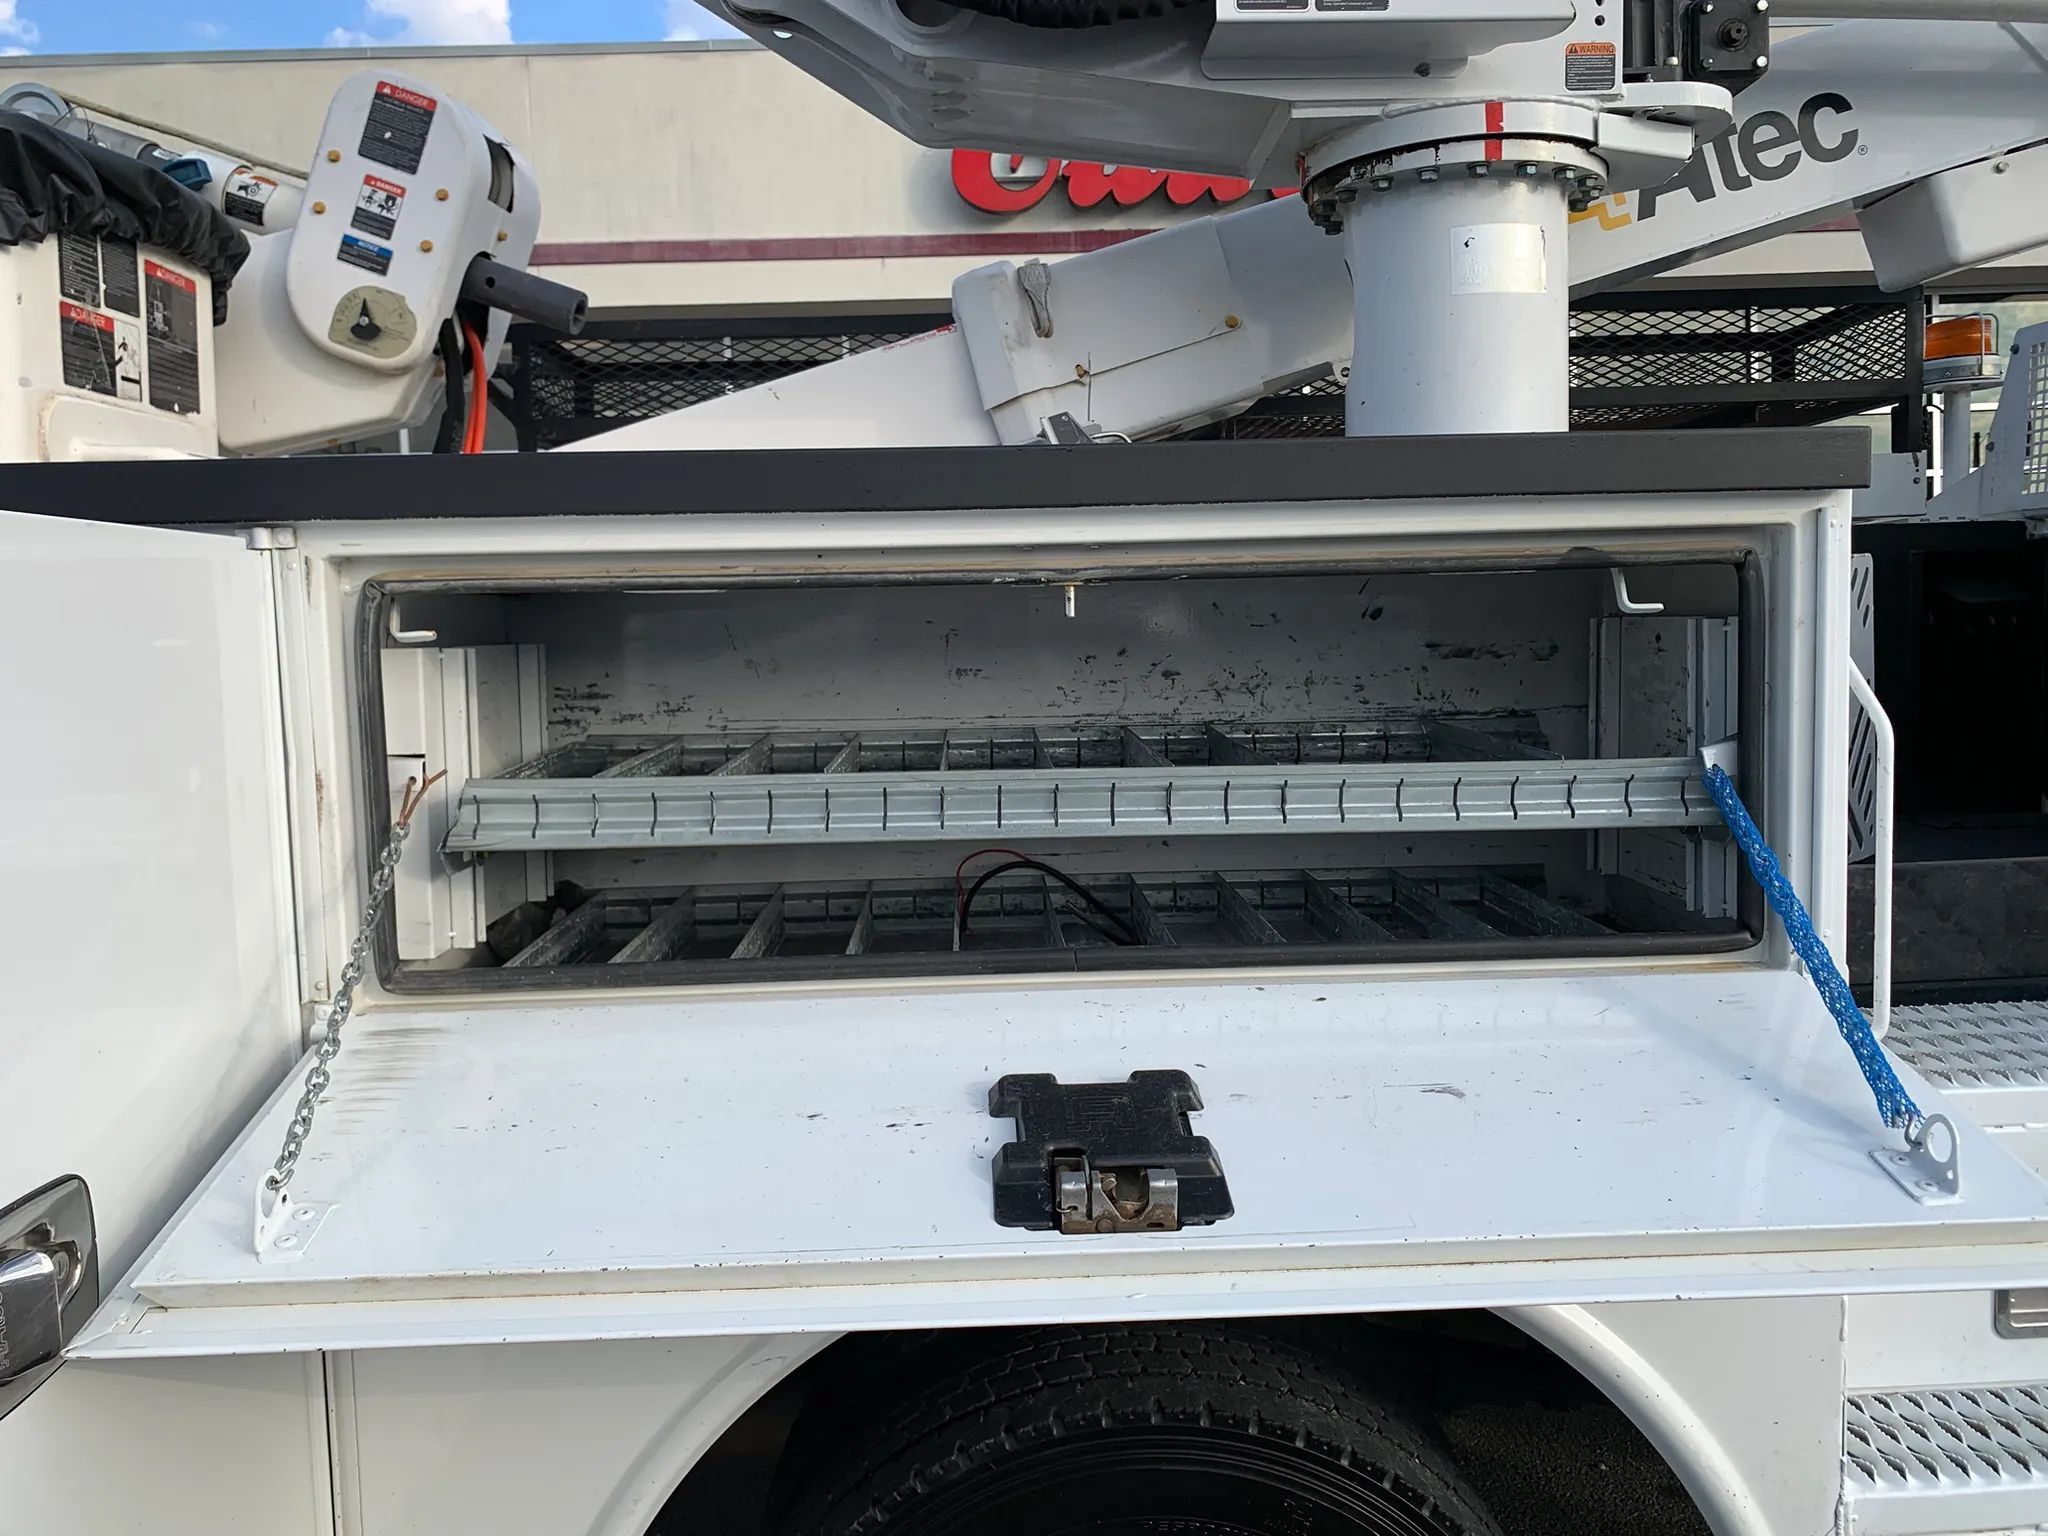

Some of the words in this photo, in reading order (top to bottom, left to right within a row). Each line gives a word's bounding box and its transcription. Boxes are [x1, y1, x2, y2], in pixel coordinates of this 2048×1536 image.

[1580, 45, 1614, 54] WARNING
[394, 89, 429, 106] DANGER
[375, 180, 403, 194] DANGER
[357, 239, 380, 252] NOTICE
